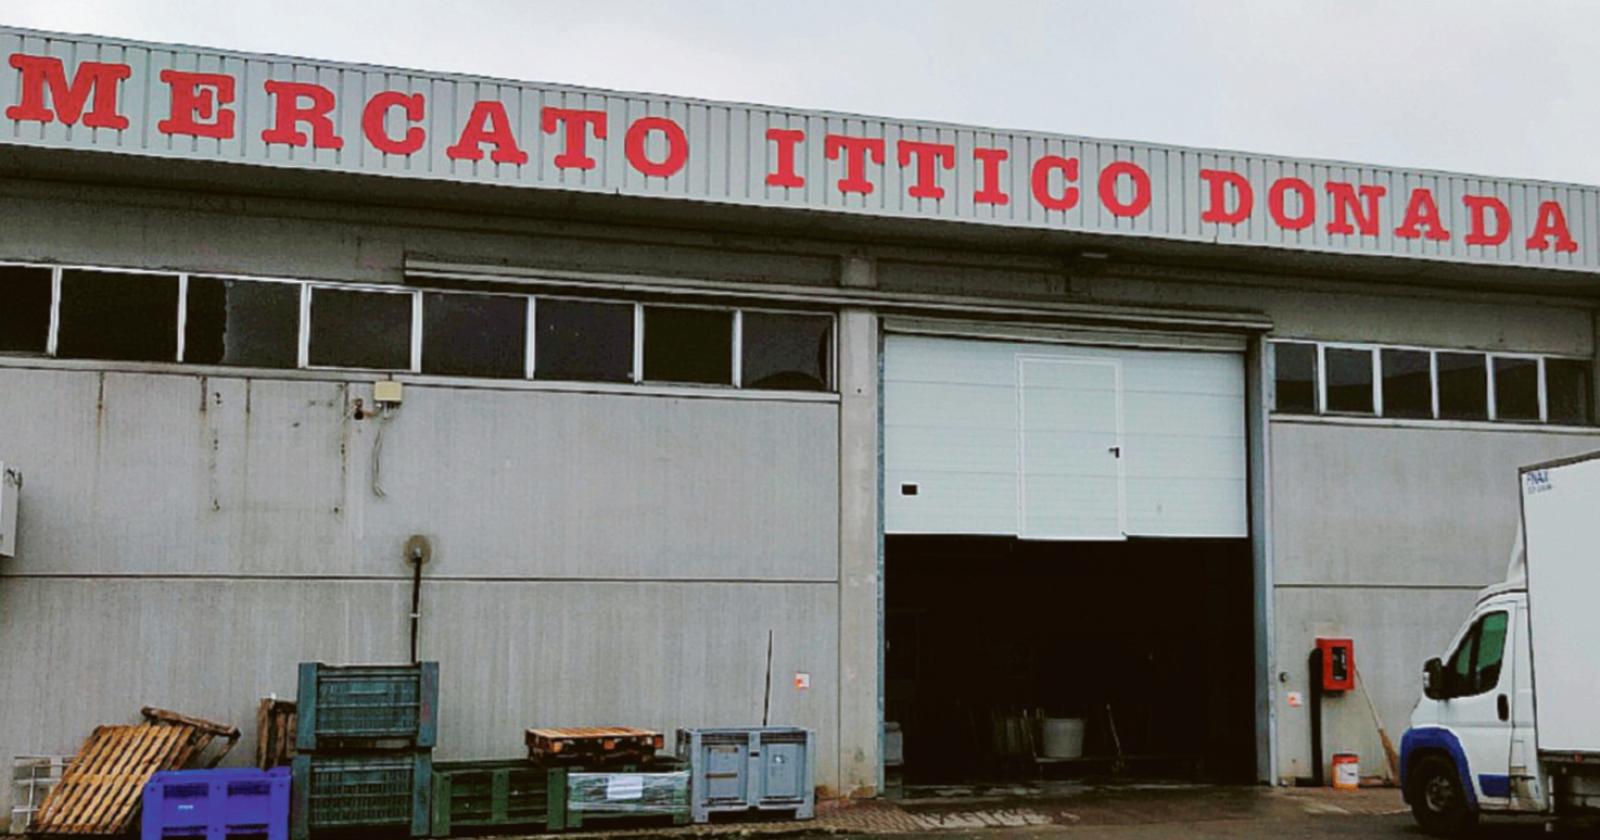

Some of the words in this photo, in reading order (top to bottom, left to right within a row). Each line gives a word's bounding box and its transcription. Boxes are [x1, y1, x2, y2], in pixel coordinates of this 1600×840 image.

[7, 53, 689, 178] MERCATO
[766, 128, 1152, 218] ITTICO
[1199, 169, 1578, 253] DONADA
